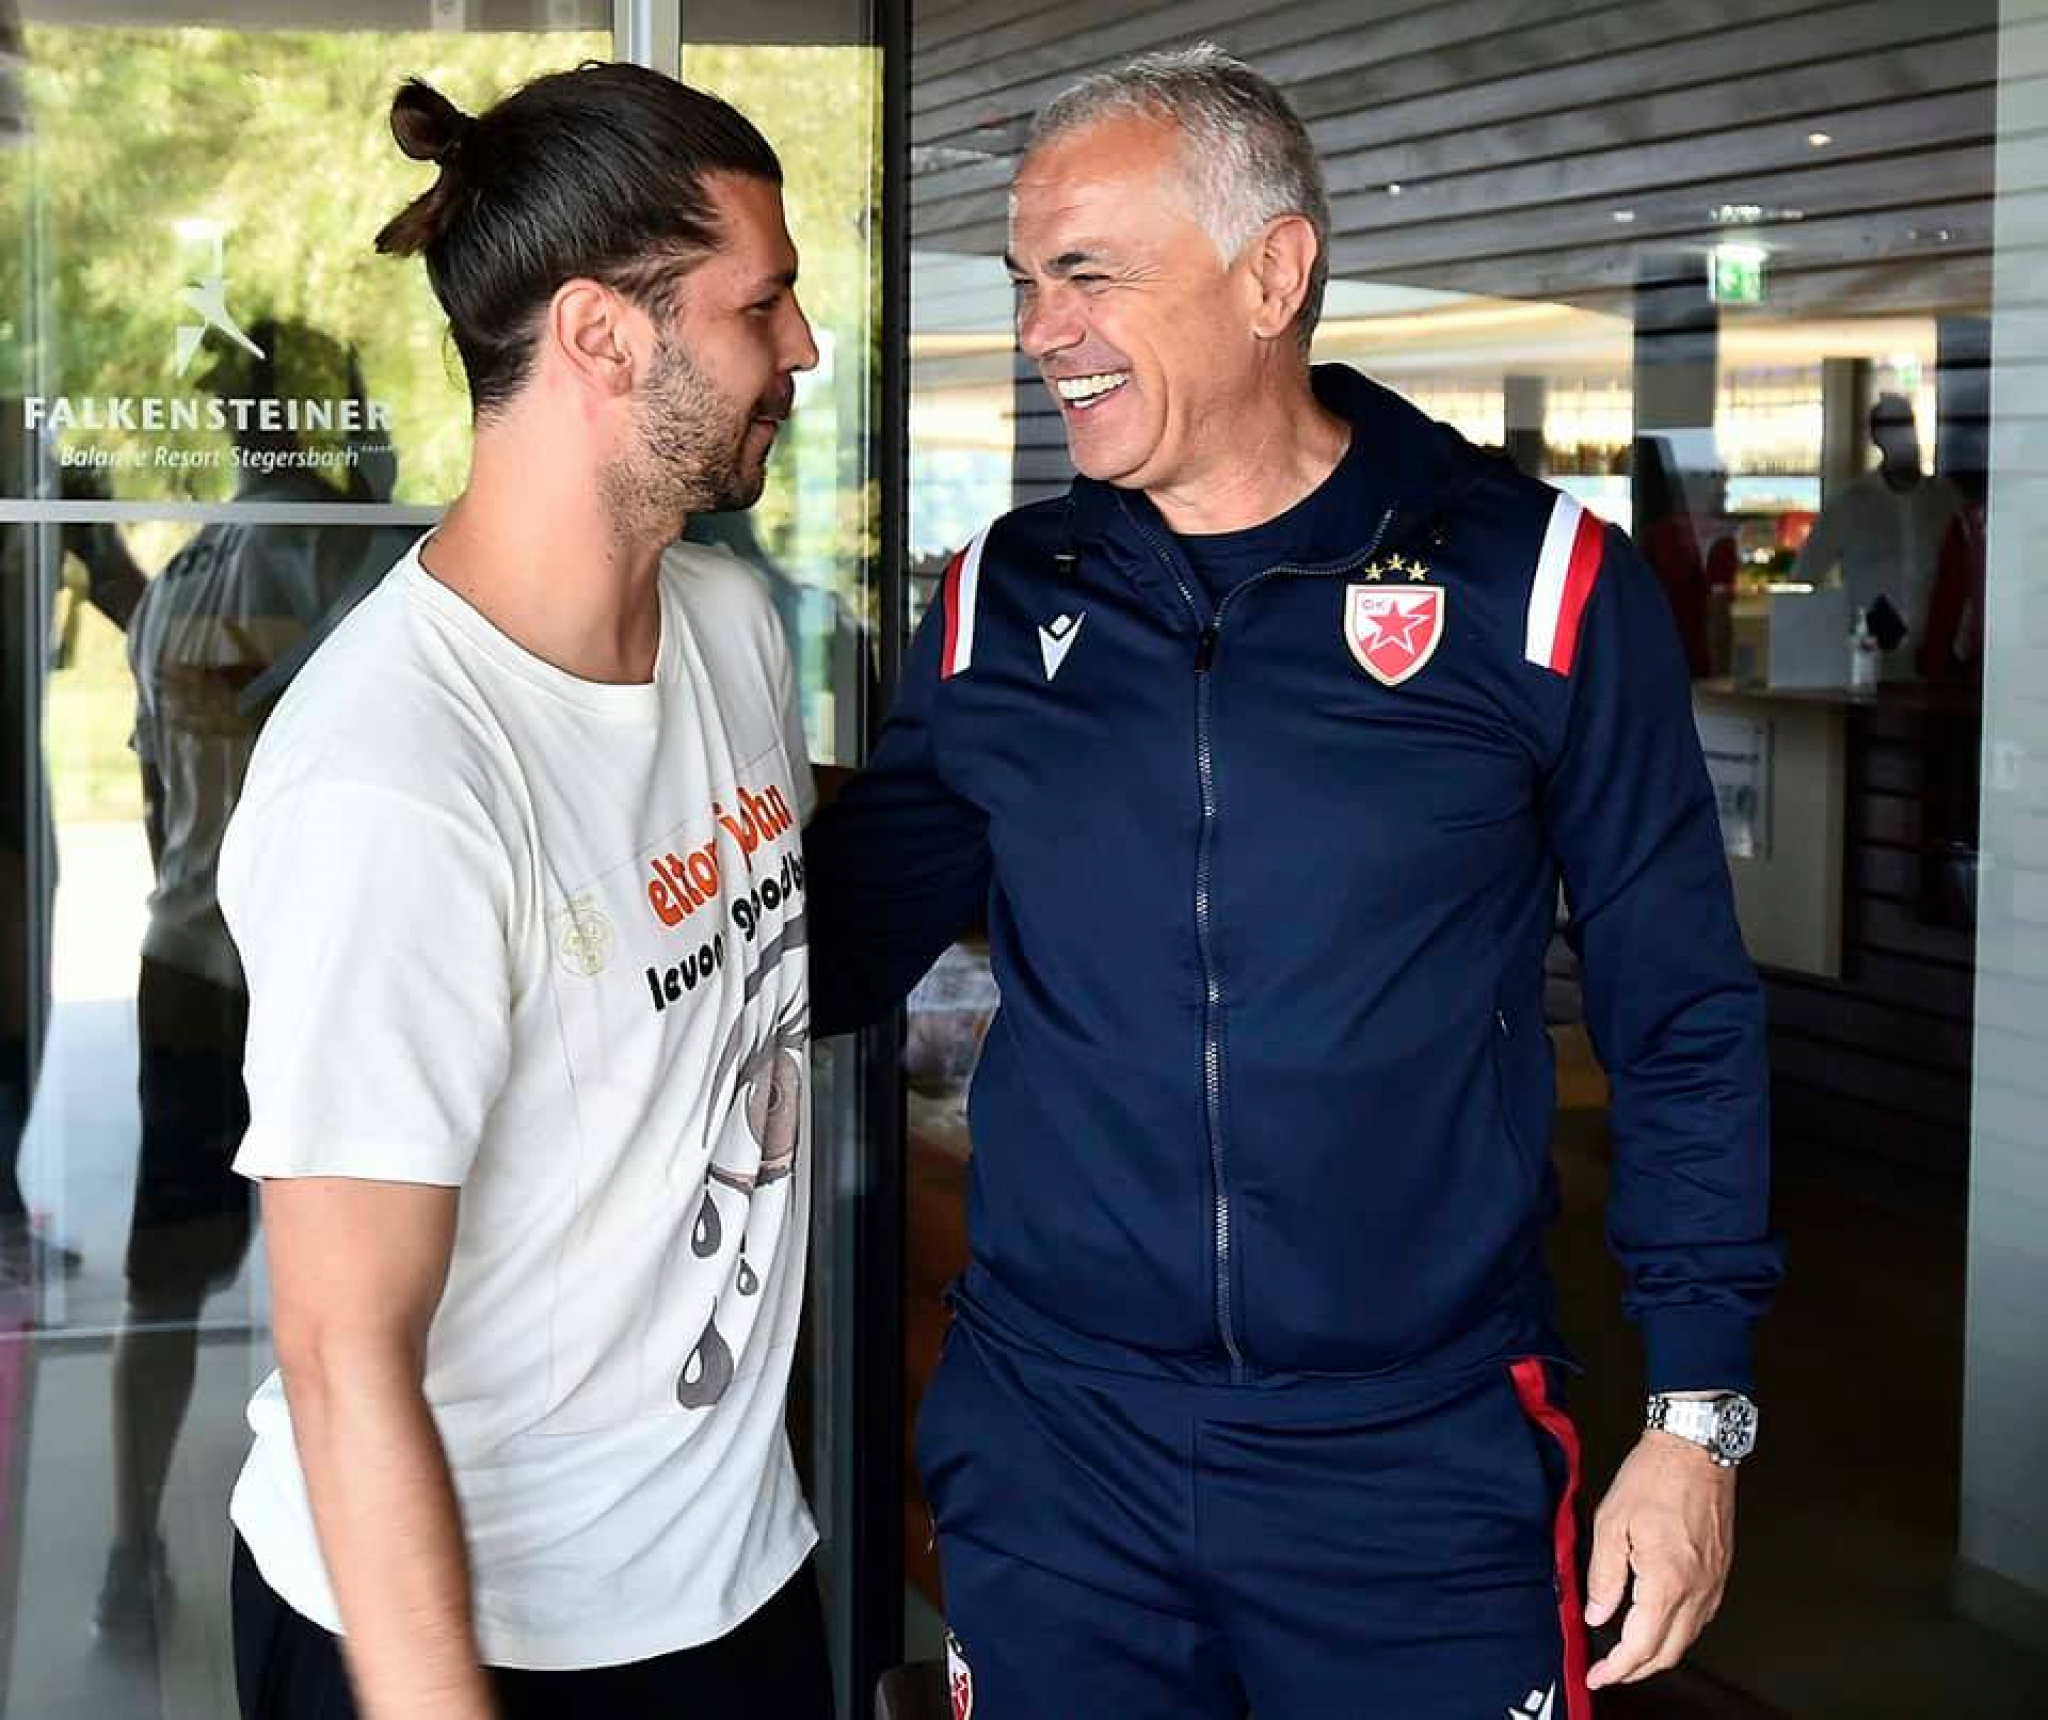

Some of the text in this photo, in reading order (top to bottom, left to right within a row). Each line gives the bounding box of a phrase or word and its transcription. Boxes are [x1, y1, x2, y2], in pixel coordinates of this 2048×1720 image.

[24, 398, 393, 430] FALKENSTEINER
[61, 445, 360, 475] Balae Resort Stegersbach
